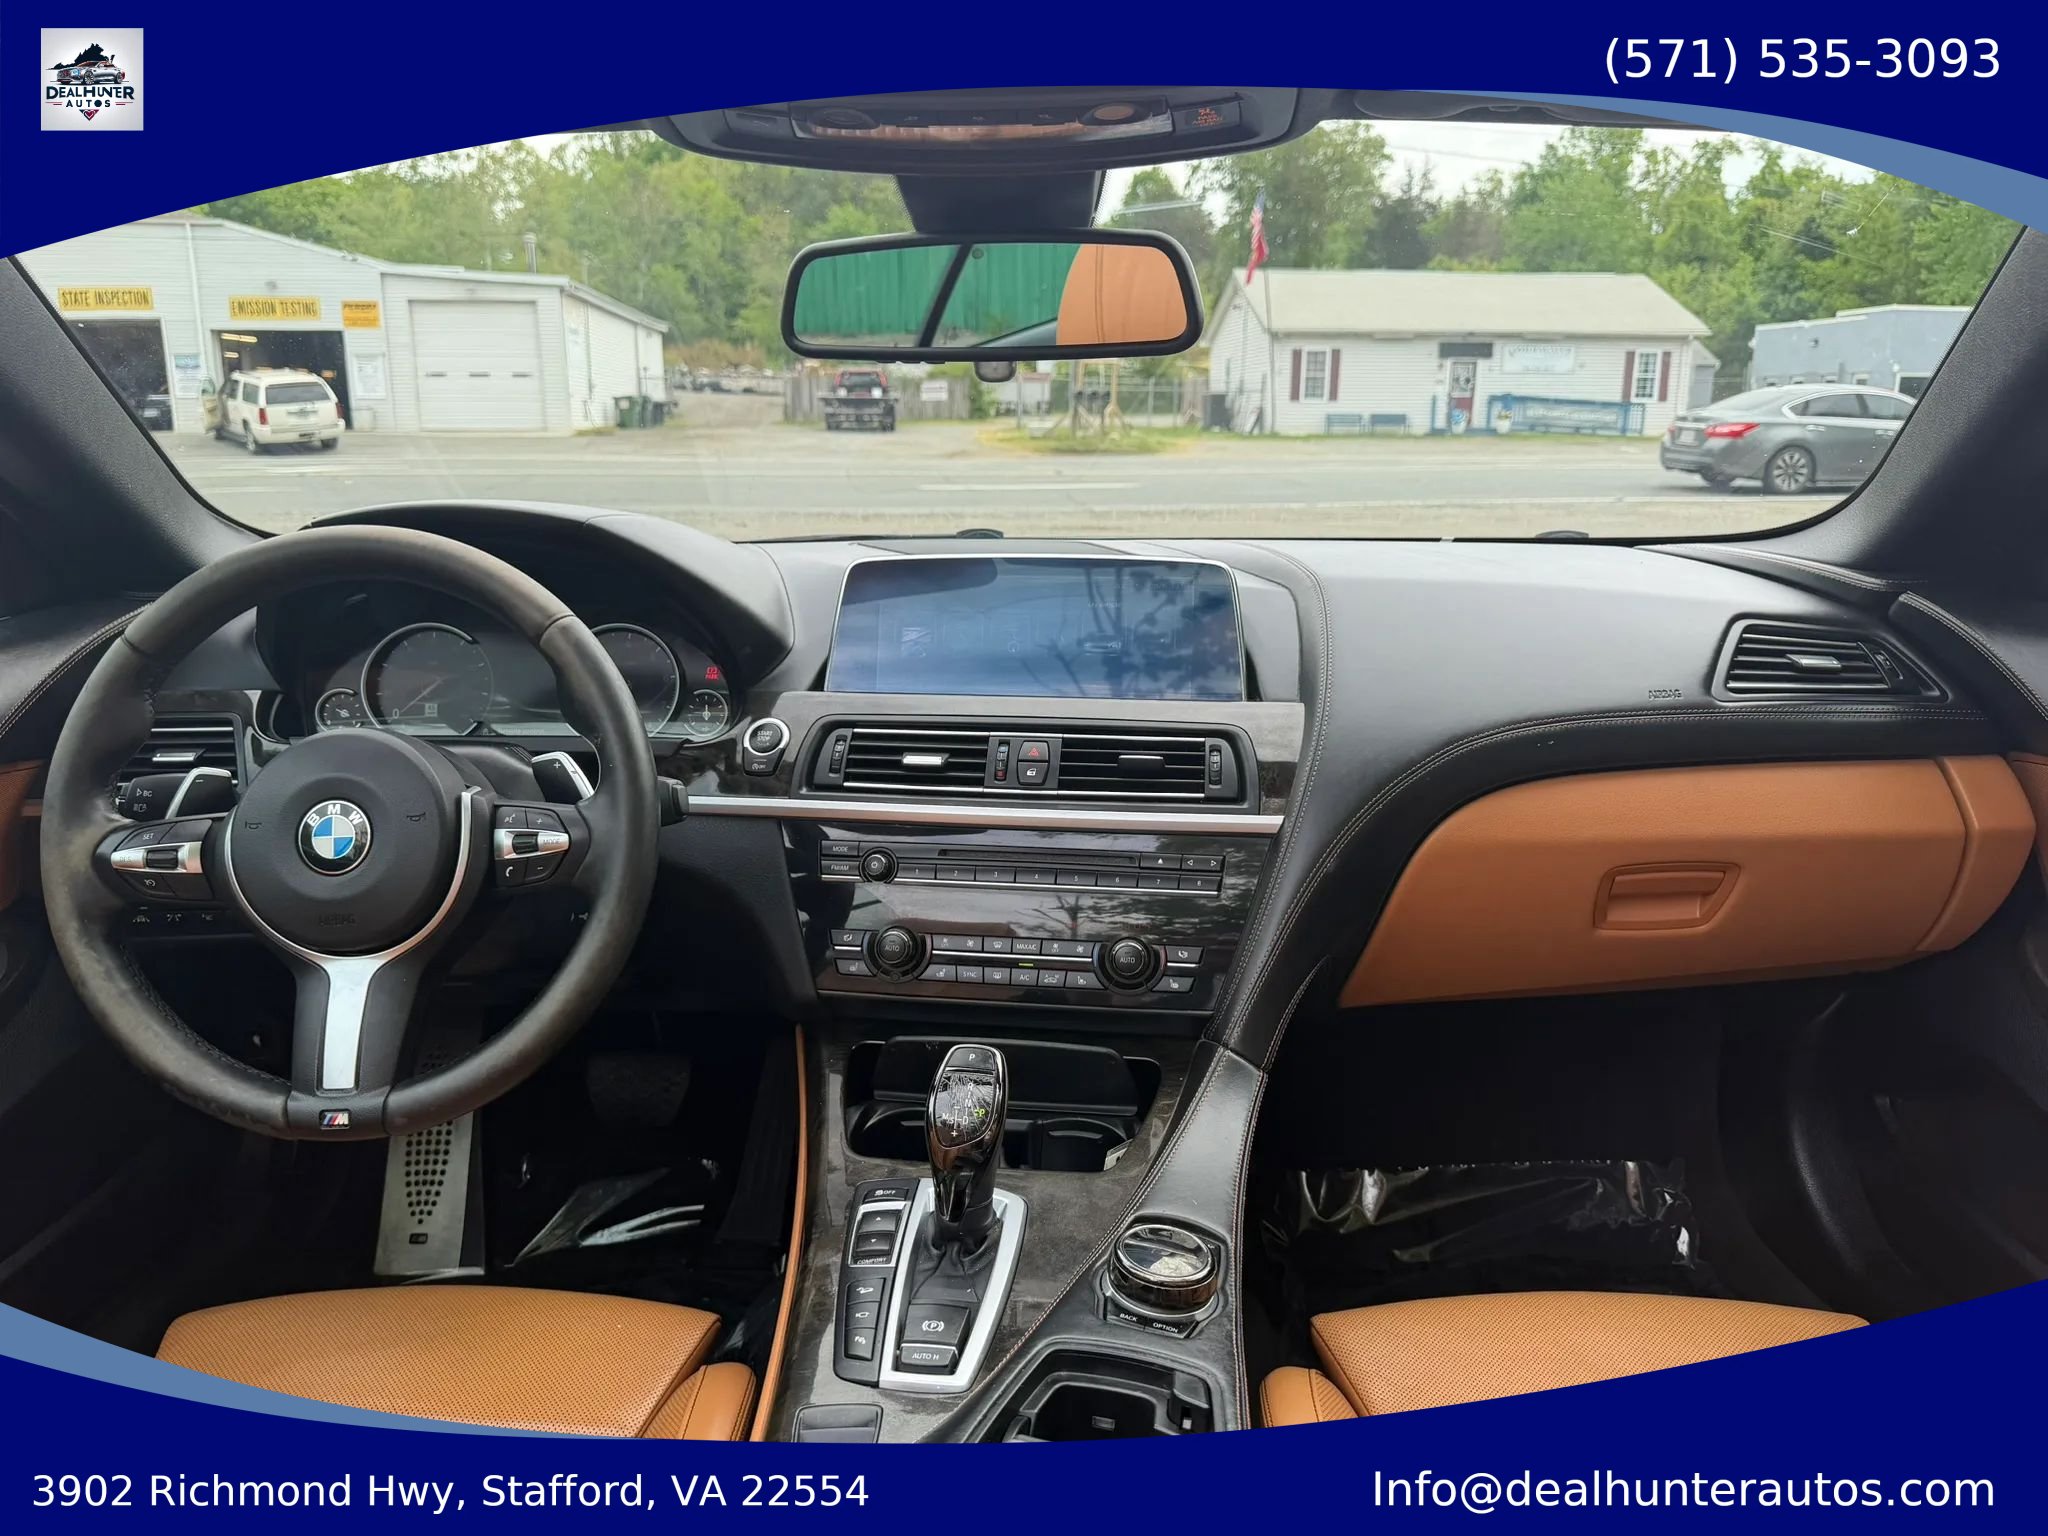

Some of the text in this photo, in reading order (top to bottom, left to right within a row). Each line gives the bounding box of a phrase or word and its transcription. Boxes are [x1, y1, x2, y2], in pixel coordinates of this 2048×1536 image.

[62, 290, 149, 307] STATE INSPECTION
[231, 300, 318, 316] EMISSION TESTING
[306, 803, 363, 828] BMW
[832, 845, 848, 853] MODE
[884, 944, 900, 952] AUTO
[1119, 956, 1136, 965] AUTO
[1019, 974, 1030, 982] A/C
[968, 1053, 976, 1061] P
[962, 1115, 969, 1125] D
[857, 1257, 887, 1265] COMFORT
[1120, 1313, 1138, 1322] BACK
[1152, 1322, 1179, 1333] OPTION
[912, 1352, 932, 1360] AUTO
